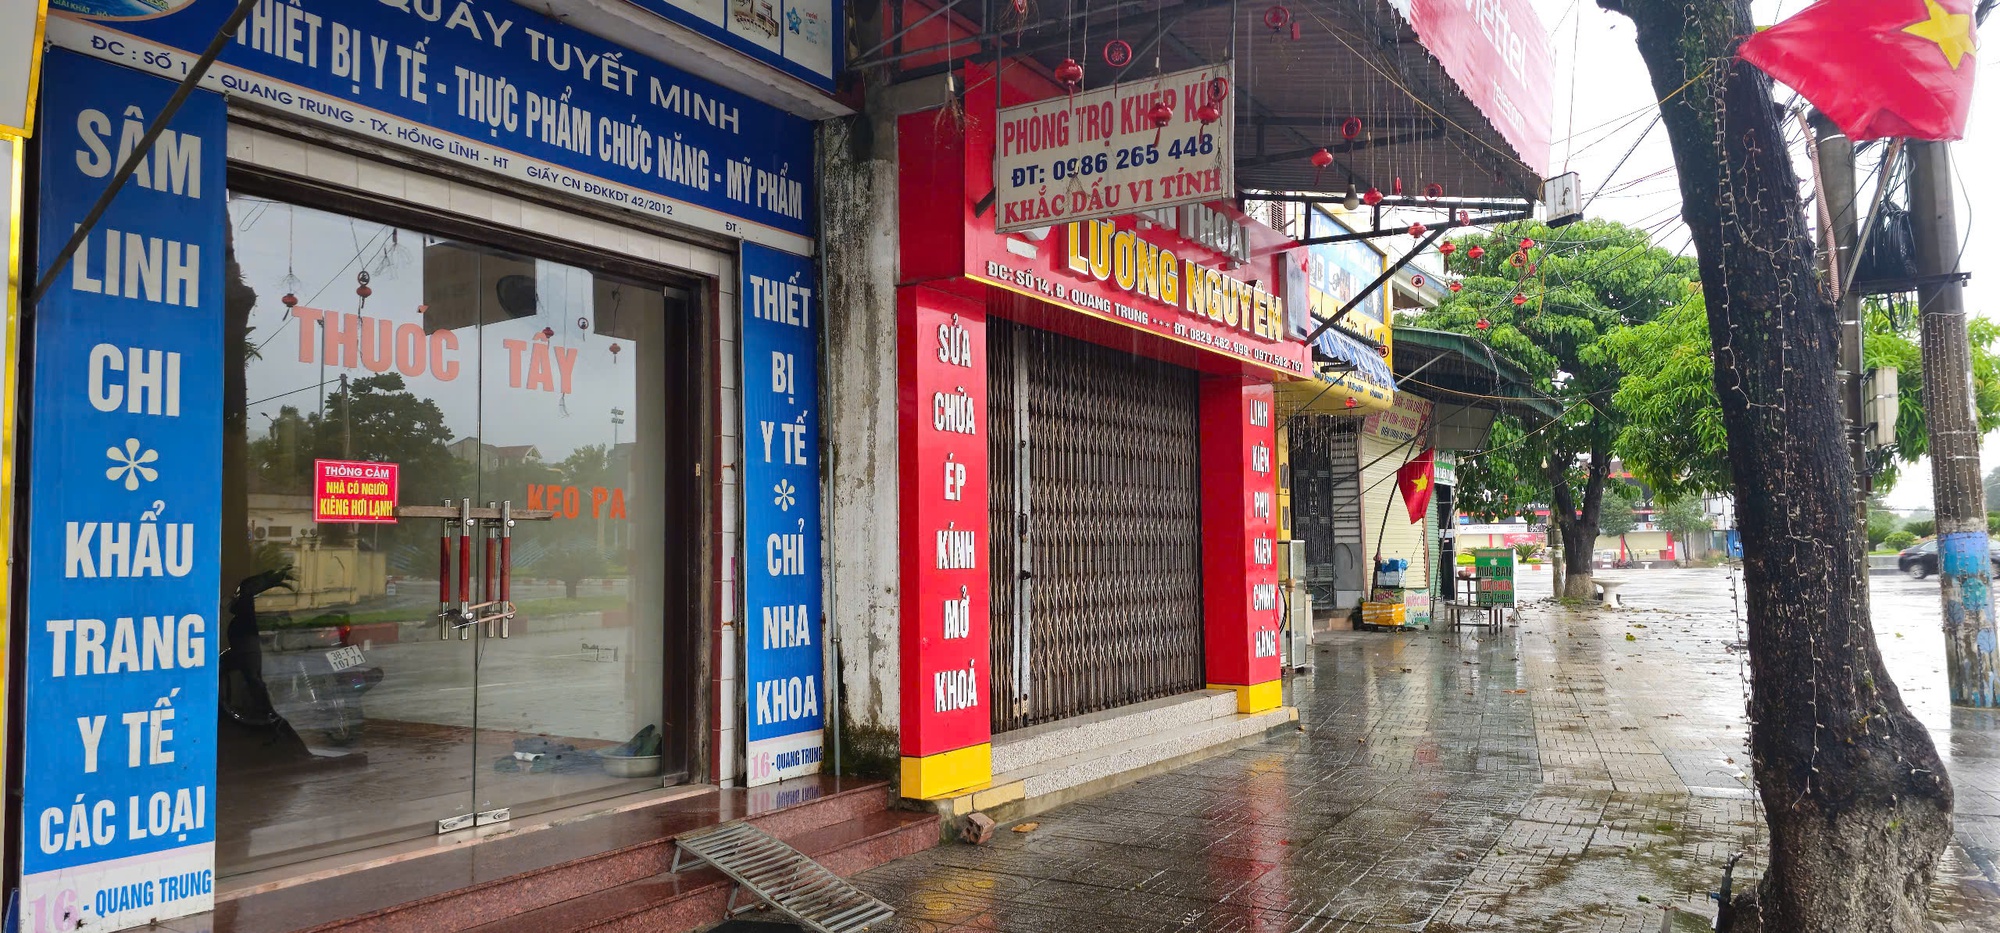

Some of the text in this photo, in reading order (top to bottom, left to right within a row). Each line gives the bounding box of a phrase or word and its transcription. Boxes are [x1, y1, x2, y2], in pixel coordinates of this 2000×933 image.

[525, 27, 639, 97] TUYẾT
[650, 76, 740, 135] MINH
[91, 35, 125, 56] ĐC
[143, 52, 173, 70] SỐ
[221, 74, 293, 106] QUANG
[298, 95, 354, 123] TRUNG
[370, 118, 393, 136] TX.
[397, 126, 445, 150] HỒNG
[448, 140, 480, 162] LĨNH
[493, 155, 510, 171] HT
[562, 176, 581, 190] CN
[631, 197, 673, 216] 42/2012
[331, 21, 361, 95] BỊ
[370, 35, 389, 90] Y
[396, 36, 428, 105] TẾ
[454, 65, 519, 138] THỰC
[525, 85, 592, 157] PHẨM
[598, 113, 653, 175] CHỨC
[657, 131, 710, 192] NĂNG
[726, 156, 753, 205] MỸ
[756, 162, 804, 221] PHẨM
[1003, 106, 1070, 158] PHÒNG
[1075, 100, 1115, 147] TRỌ
[76, 105, 201, 199] SÂM
[1012, 133, 1214, 189] ĐT: 0986 265 448
[1003, 166, 1222, 224] KHẮC DẤU VI TÍNH
[725, 220, 738, 234] ĐT
[72, 221, 200, 308] LINH
[1067, 217, 1180, 307] LƯƠNG
[1183, 257, 1285, 344] NGUYÊN
[750, 271, 812, 329] THIẾT
[1015, 268, 1034, 288] SỐ
[1071, 289, 1111, 313] QUANG
[1114, 302, 1149, 325] TRUNG
[503, 331, 579, 395] TÂY
[937, 313, 972, 368] SỬA
[88, 343, 181, 417] CHI
[771, 351, 795, 405] BỊ
[760, 410, 808, 466] Y TẾ
[933, 386, 976, 436] CHỮA
[1249, 398, 1268, 428] LINH
[325, 465, 363, 477] THÔNG
[326, 480, 389, 496] NHÀ CÓ NGƯỜI
[943, 452, 967, 501] ÉP
[320, 495, 393, 520] KIÊNG HƠI LẠNH
[526, 484, 627, 520] KEO PA
[1253, 491, 1270, 524] PHỤ
[65, 500, 194, 578] KHẨU
[767, 518, 805, 577] CHỈ
[937, 522, 976, 570] KÍNH
[763, 604, 810, 650] NHA
[943, 585, 970, 640] MỞ
[46, 613, 206, 678] TRANG
[756, 675, 818, 725] KHOA
[934, 659, 978, 713] KHOÁ
[77, 688, 181, 774] Y TẾ
[752, 751, 771, 779] 16
[776, 750, 800, 771] QUANG
[801, 745, 823, 765] TRUNG
[39, 785, 206, 855] CÁC LOẠI
[29, 888, 79, 933] 16
[95, 880, 154, 918] QUANG
[158, 869, 212, 903] TRUNG
